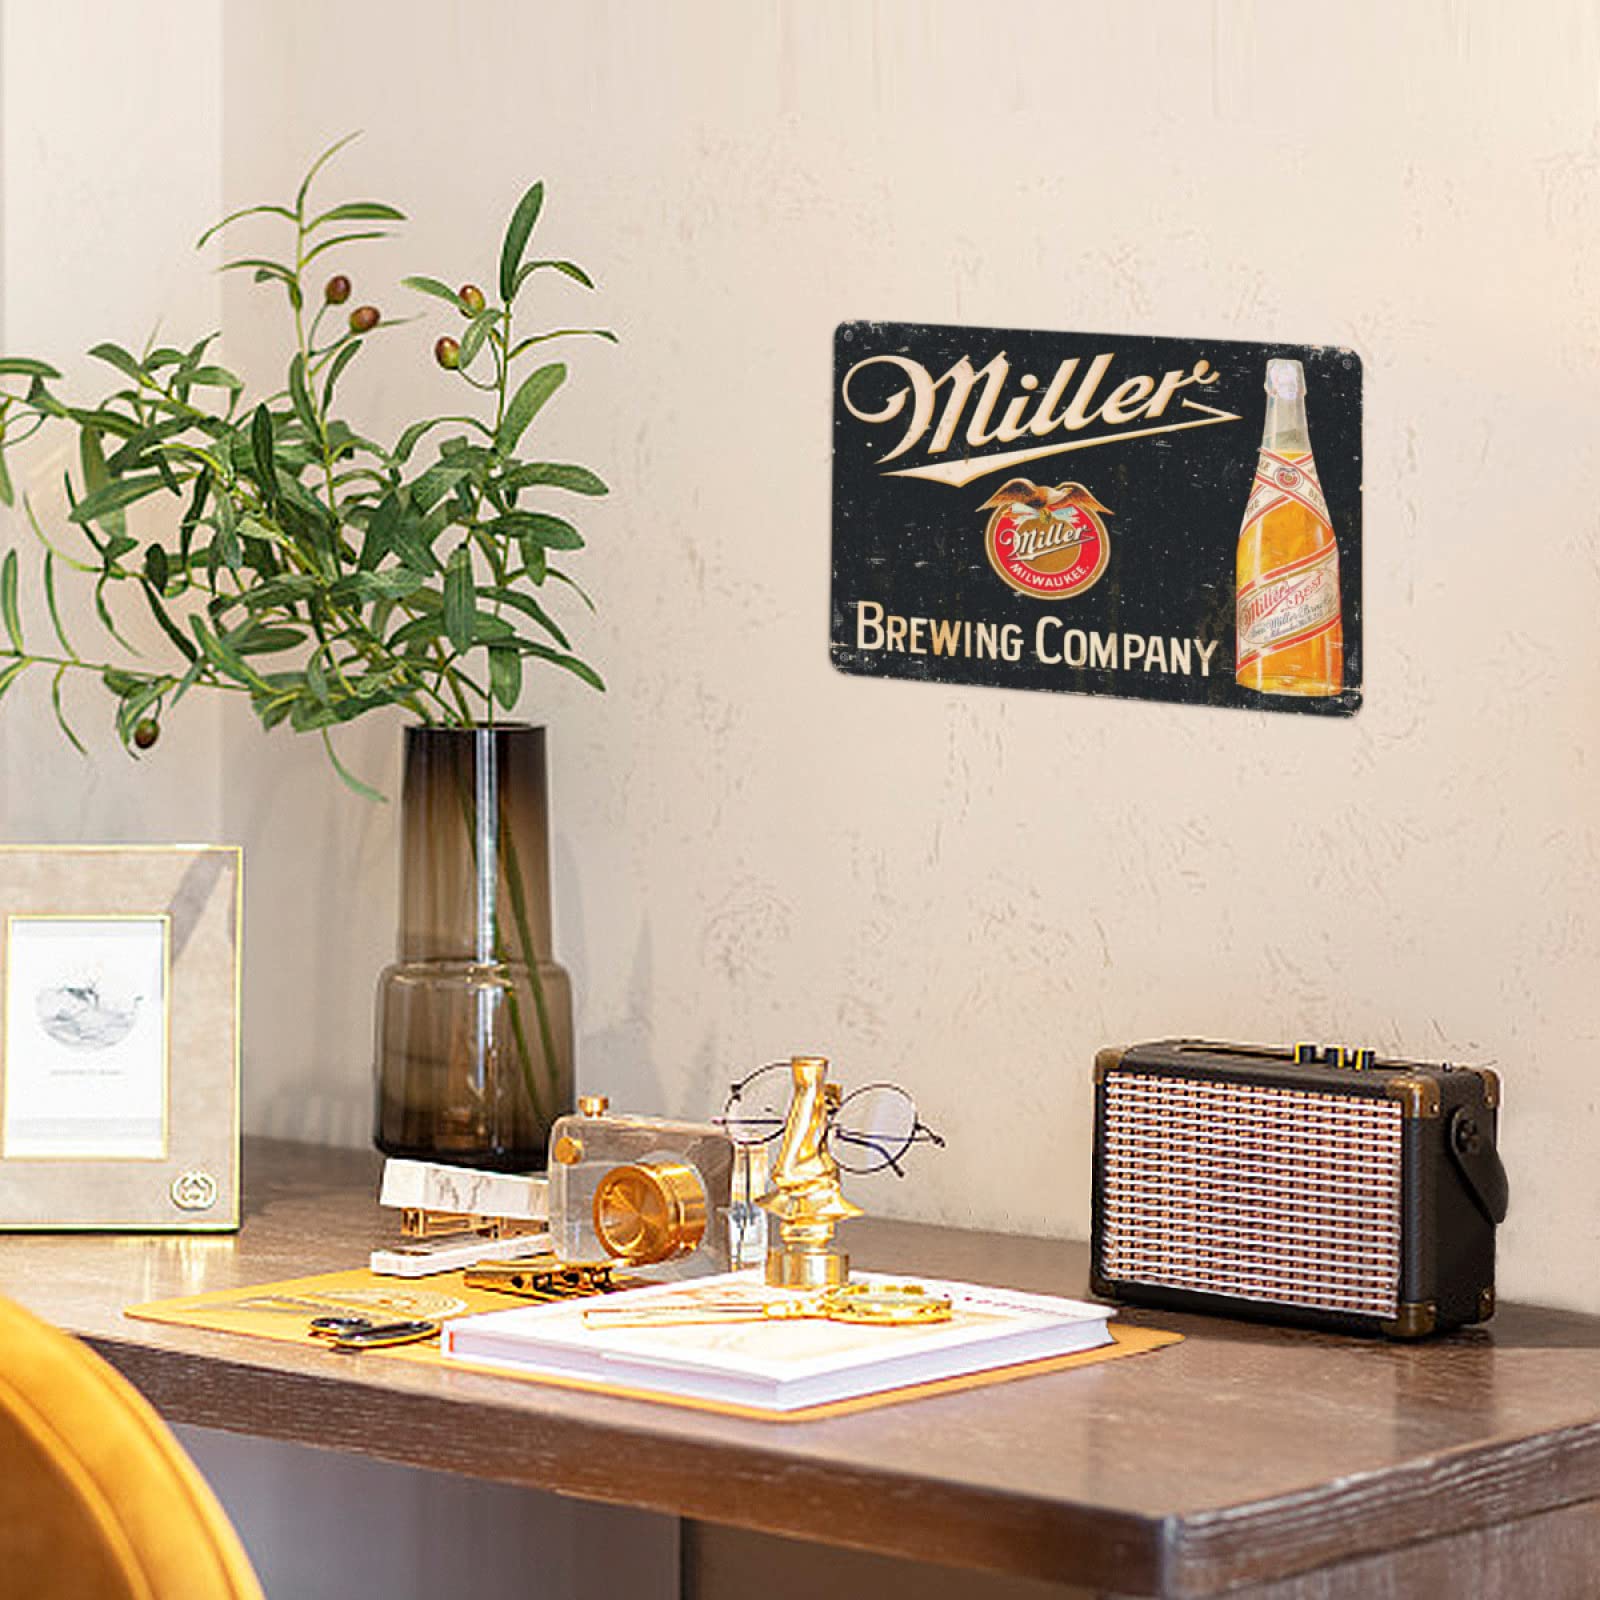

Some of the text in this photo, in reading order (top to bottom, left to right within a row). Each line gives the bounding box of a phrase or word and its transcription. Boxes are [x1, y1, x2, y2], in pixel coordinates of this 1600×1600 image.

[842, 351, 1232, 474] Miller
[1000, 523, 1093, 559] Miller
[856, 602, 1025, 662] BREWING
[1036, 615, 1219, 678] COMPANY
